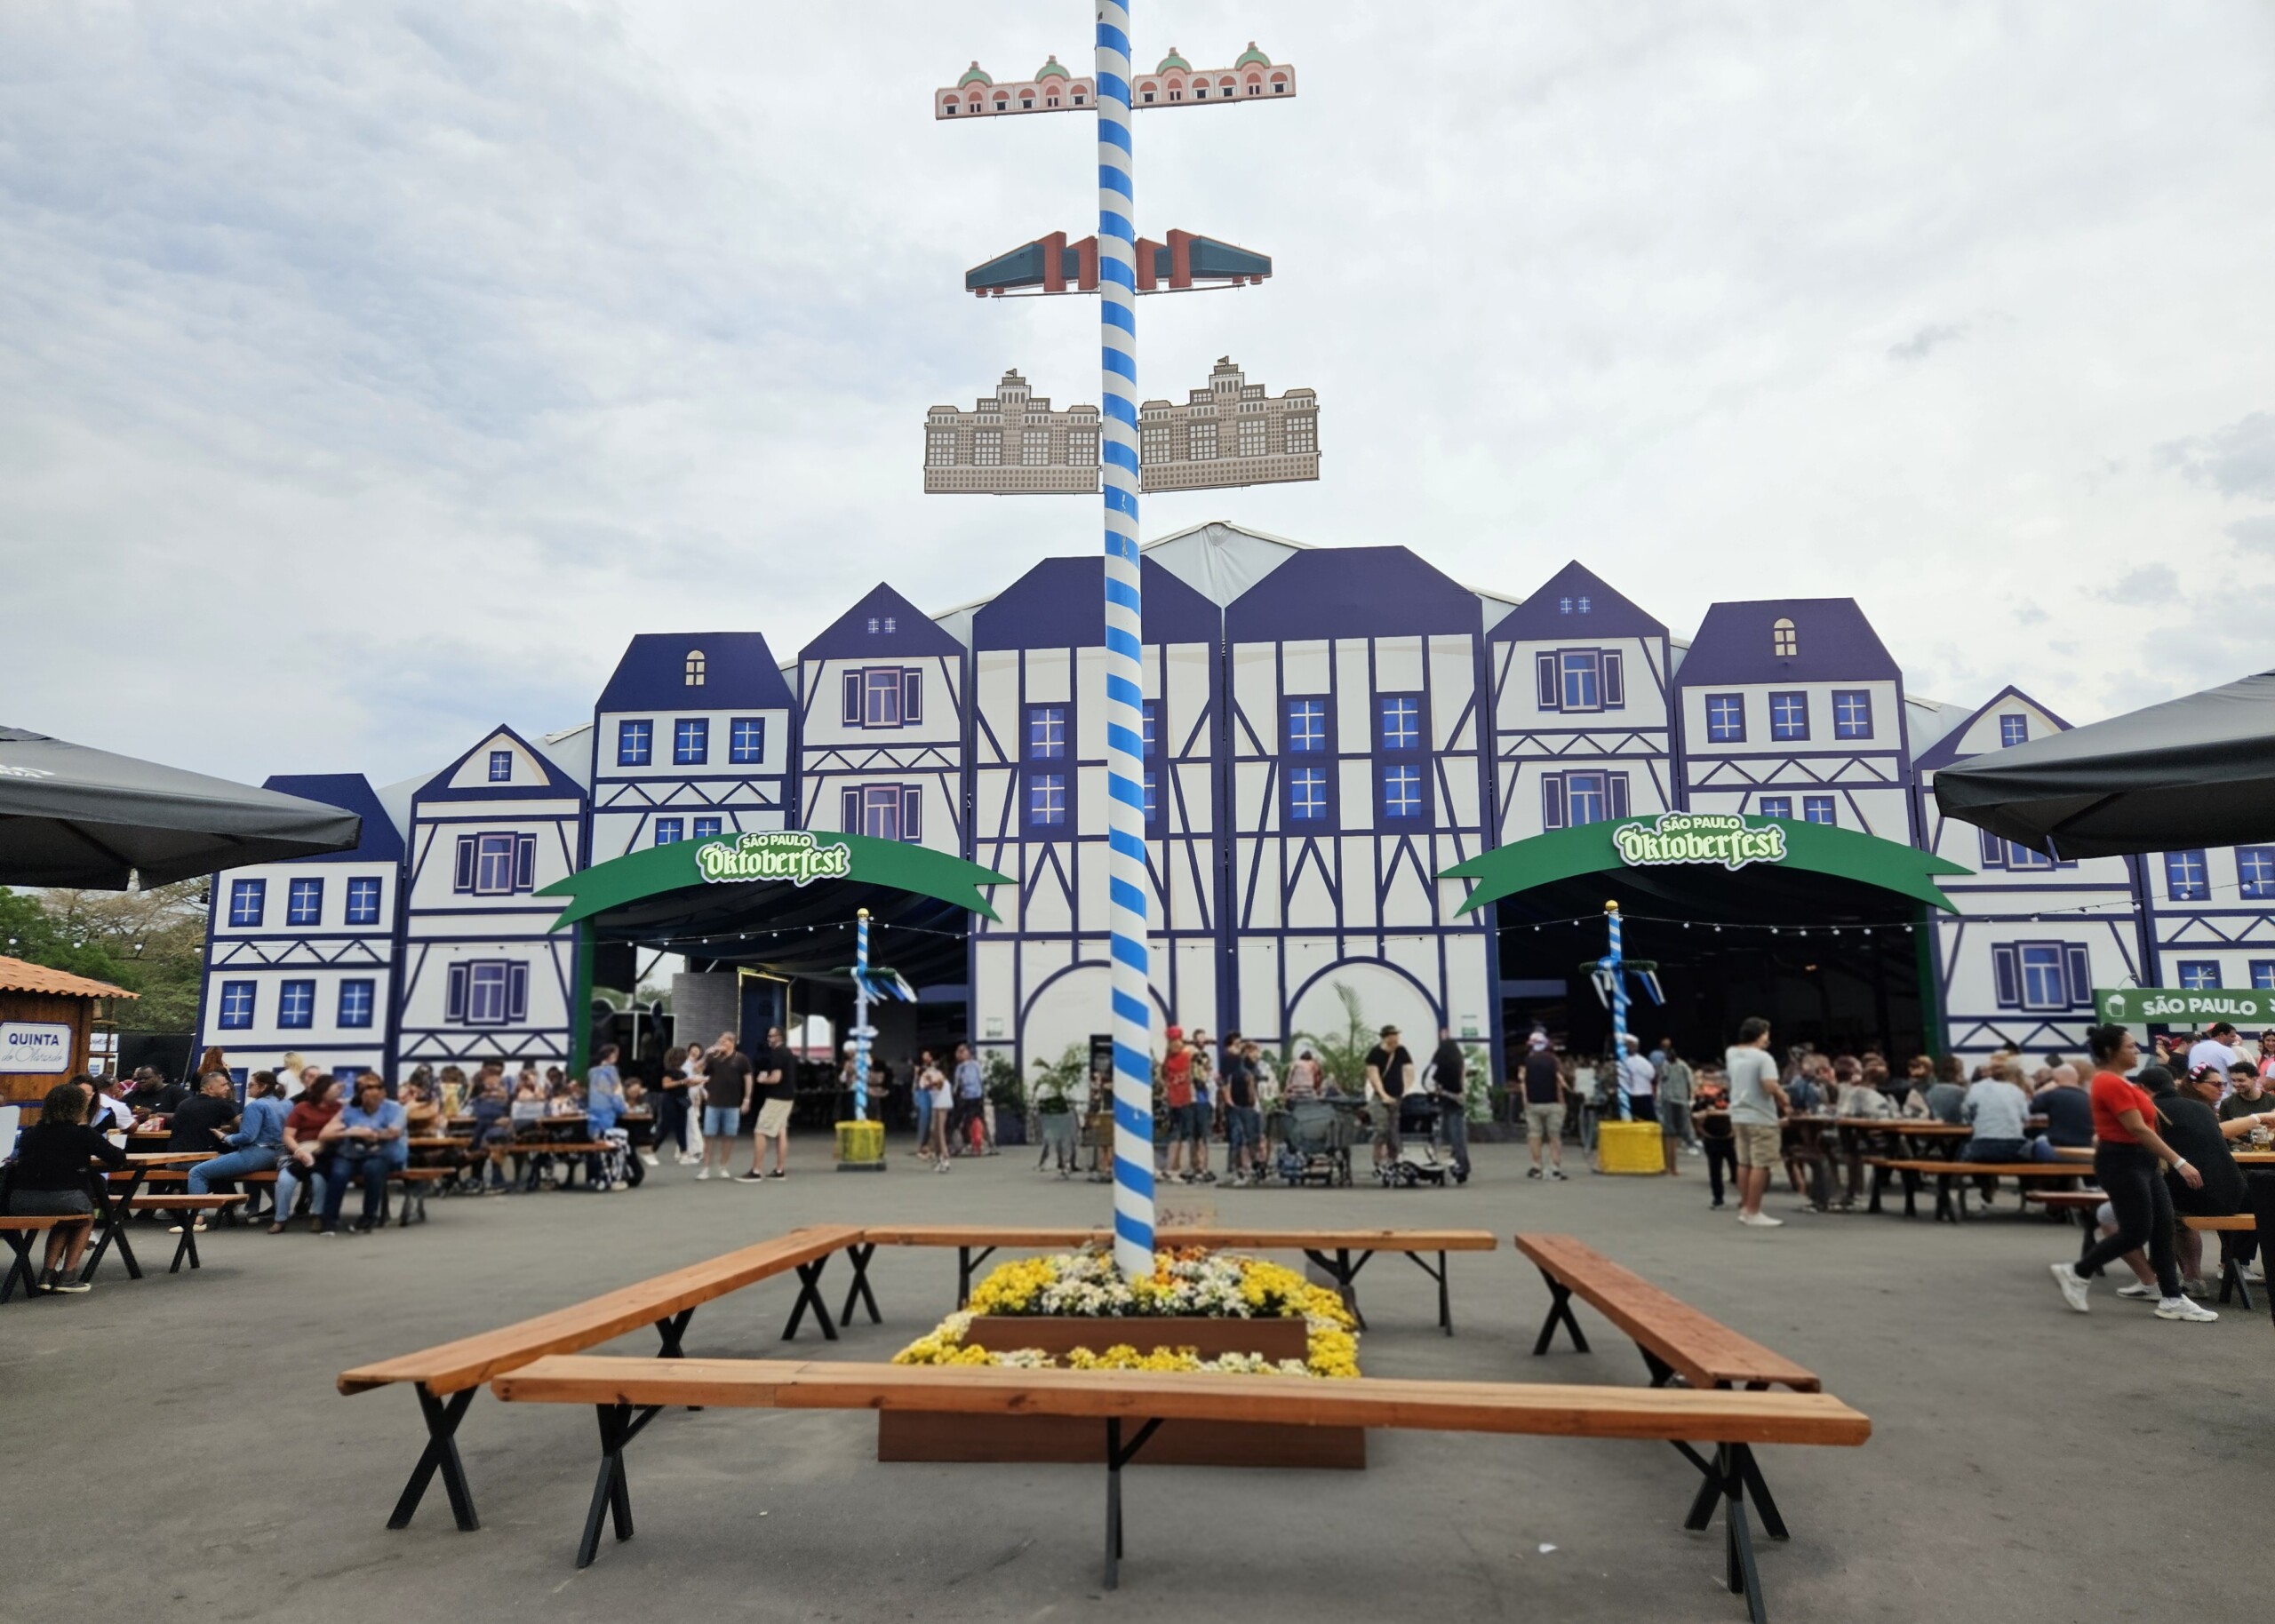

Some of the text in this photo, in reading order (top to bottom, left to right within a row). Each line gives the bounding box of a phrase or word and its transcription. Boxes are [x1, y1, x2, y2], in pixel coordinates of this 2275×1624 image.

[1661, 816, 1741, 832] SÃO PAULO
[742, 834, 811, 848] SÃO PAULO
[1618, 828, 1782, 865] Oktoberfest
[702, 845, 845, 881] Oktoberfest
[2142, 995, 2185, 1016] SÃO
[2189, 997, 2257, 1016] PAULO
[8, 1032, 60, 1046] QUINTA
